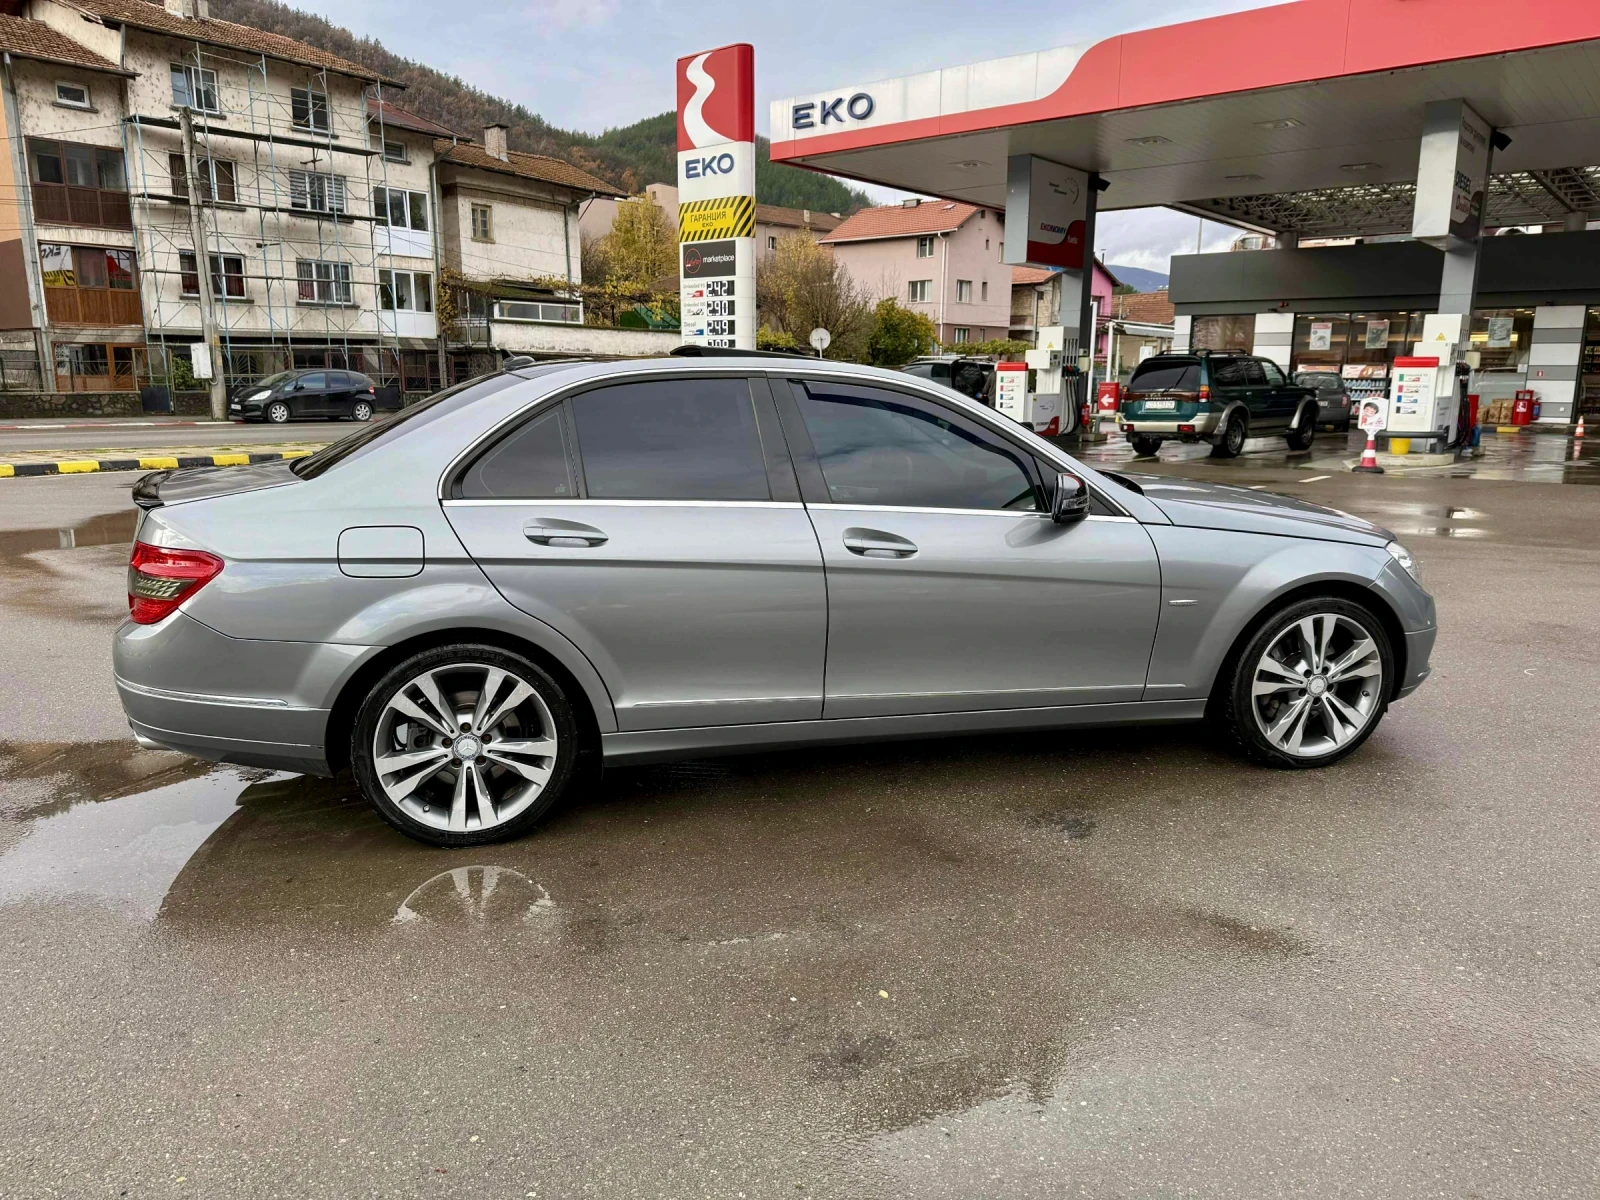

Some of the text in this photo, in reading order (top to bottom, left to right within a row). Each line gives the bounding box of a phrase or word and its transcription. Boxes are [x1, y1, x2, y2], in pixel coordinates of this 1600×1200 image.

[792, 93, 874, 130] EKO
[685, 153, 734, 179] EKO
[690, 211, 727, 223] ГАРАНЦИЯ
[702, 254, 735, 264] marketplace
